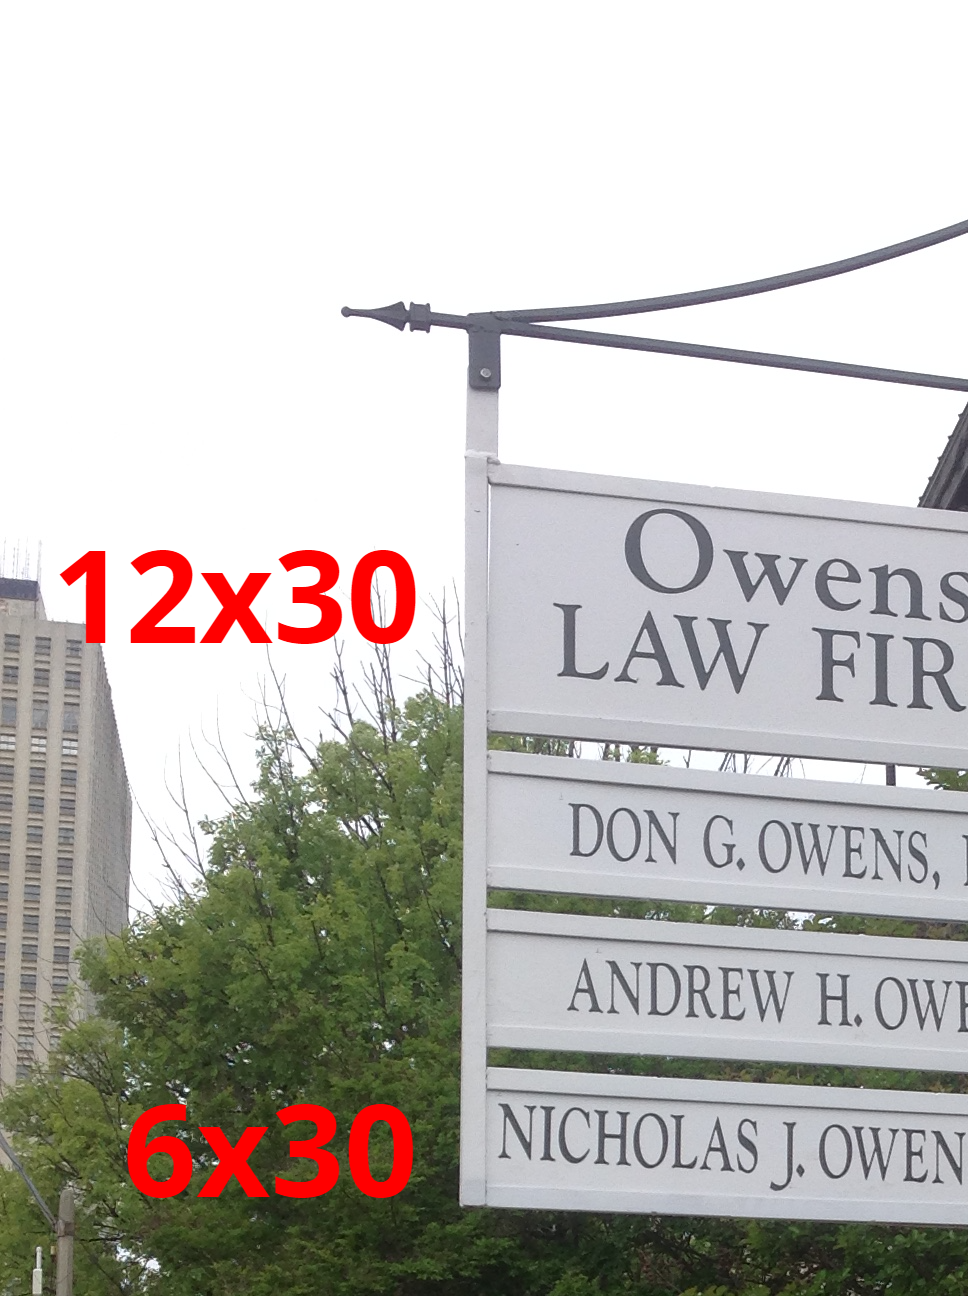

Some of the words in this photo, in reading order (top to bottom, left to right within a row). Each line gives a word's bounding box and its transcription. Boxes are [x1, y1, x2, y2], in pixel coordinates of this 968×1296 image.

[552, 602, 770, 695] LAW
[568, 802, 680, 865] DON
[703, 814, 746, 871] G.
[758, 819, 940, 890] OWENS,
[566, 958, 795, 1023] ANDREW
[815, 972, 863, 1028] H.
[497, 1102, 758, 1174] NICHOLAS
[769, 1121, 805, 1190] J.
